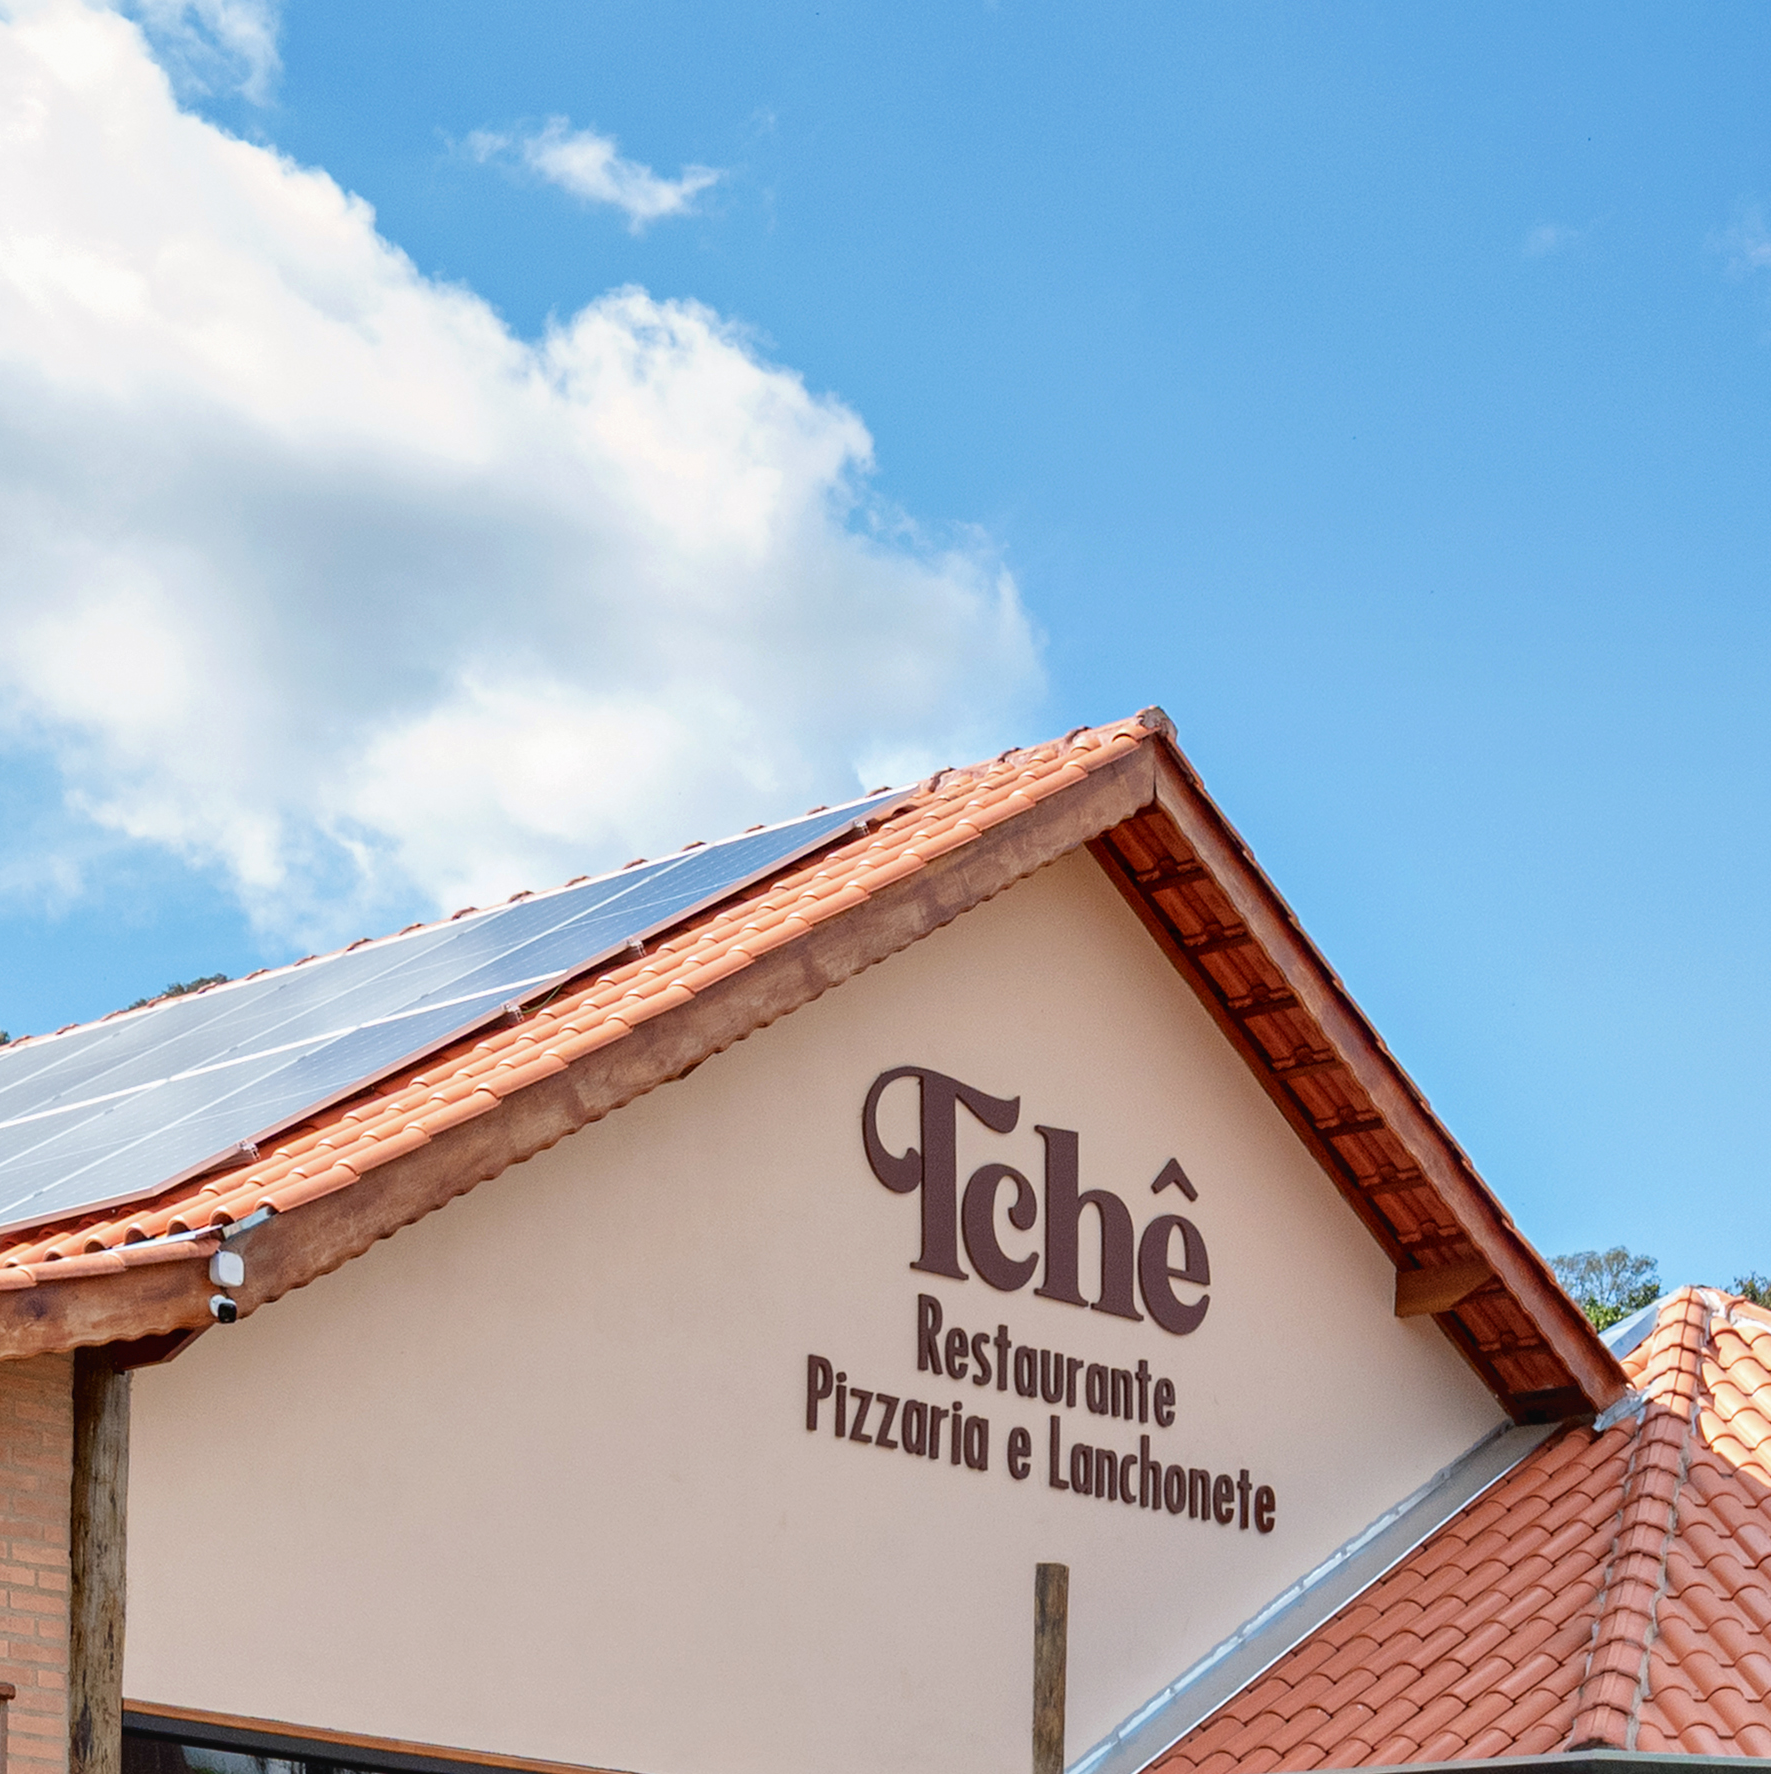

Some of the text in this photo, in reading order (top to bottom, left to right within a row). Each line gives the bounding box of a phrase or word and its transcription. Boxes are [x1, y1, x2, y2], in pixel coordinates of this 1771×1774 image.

[862, 1066, 1211, 1335] Tchê
[806, 1354, 1276, 1534] Pizzaria e Lanchonete
[917, 1293, 1176, 1427] Restaurante
